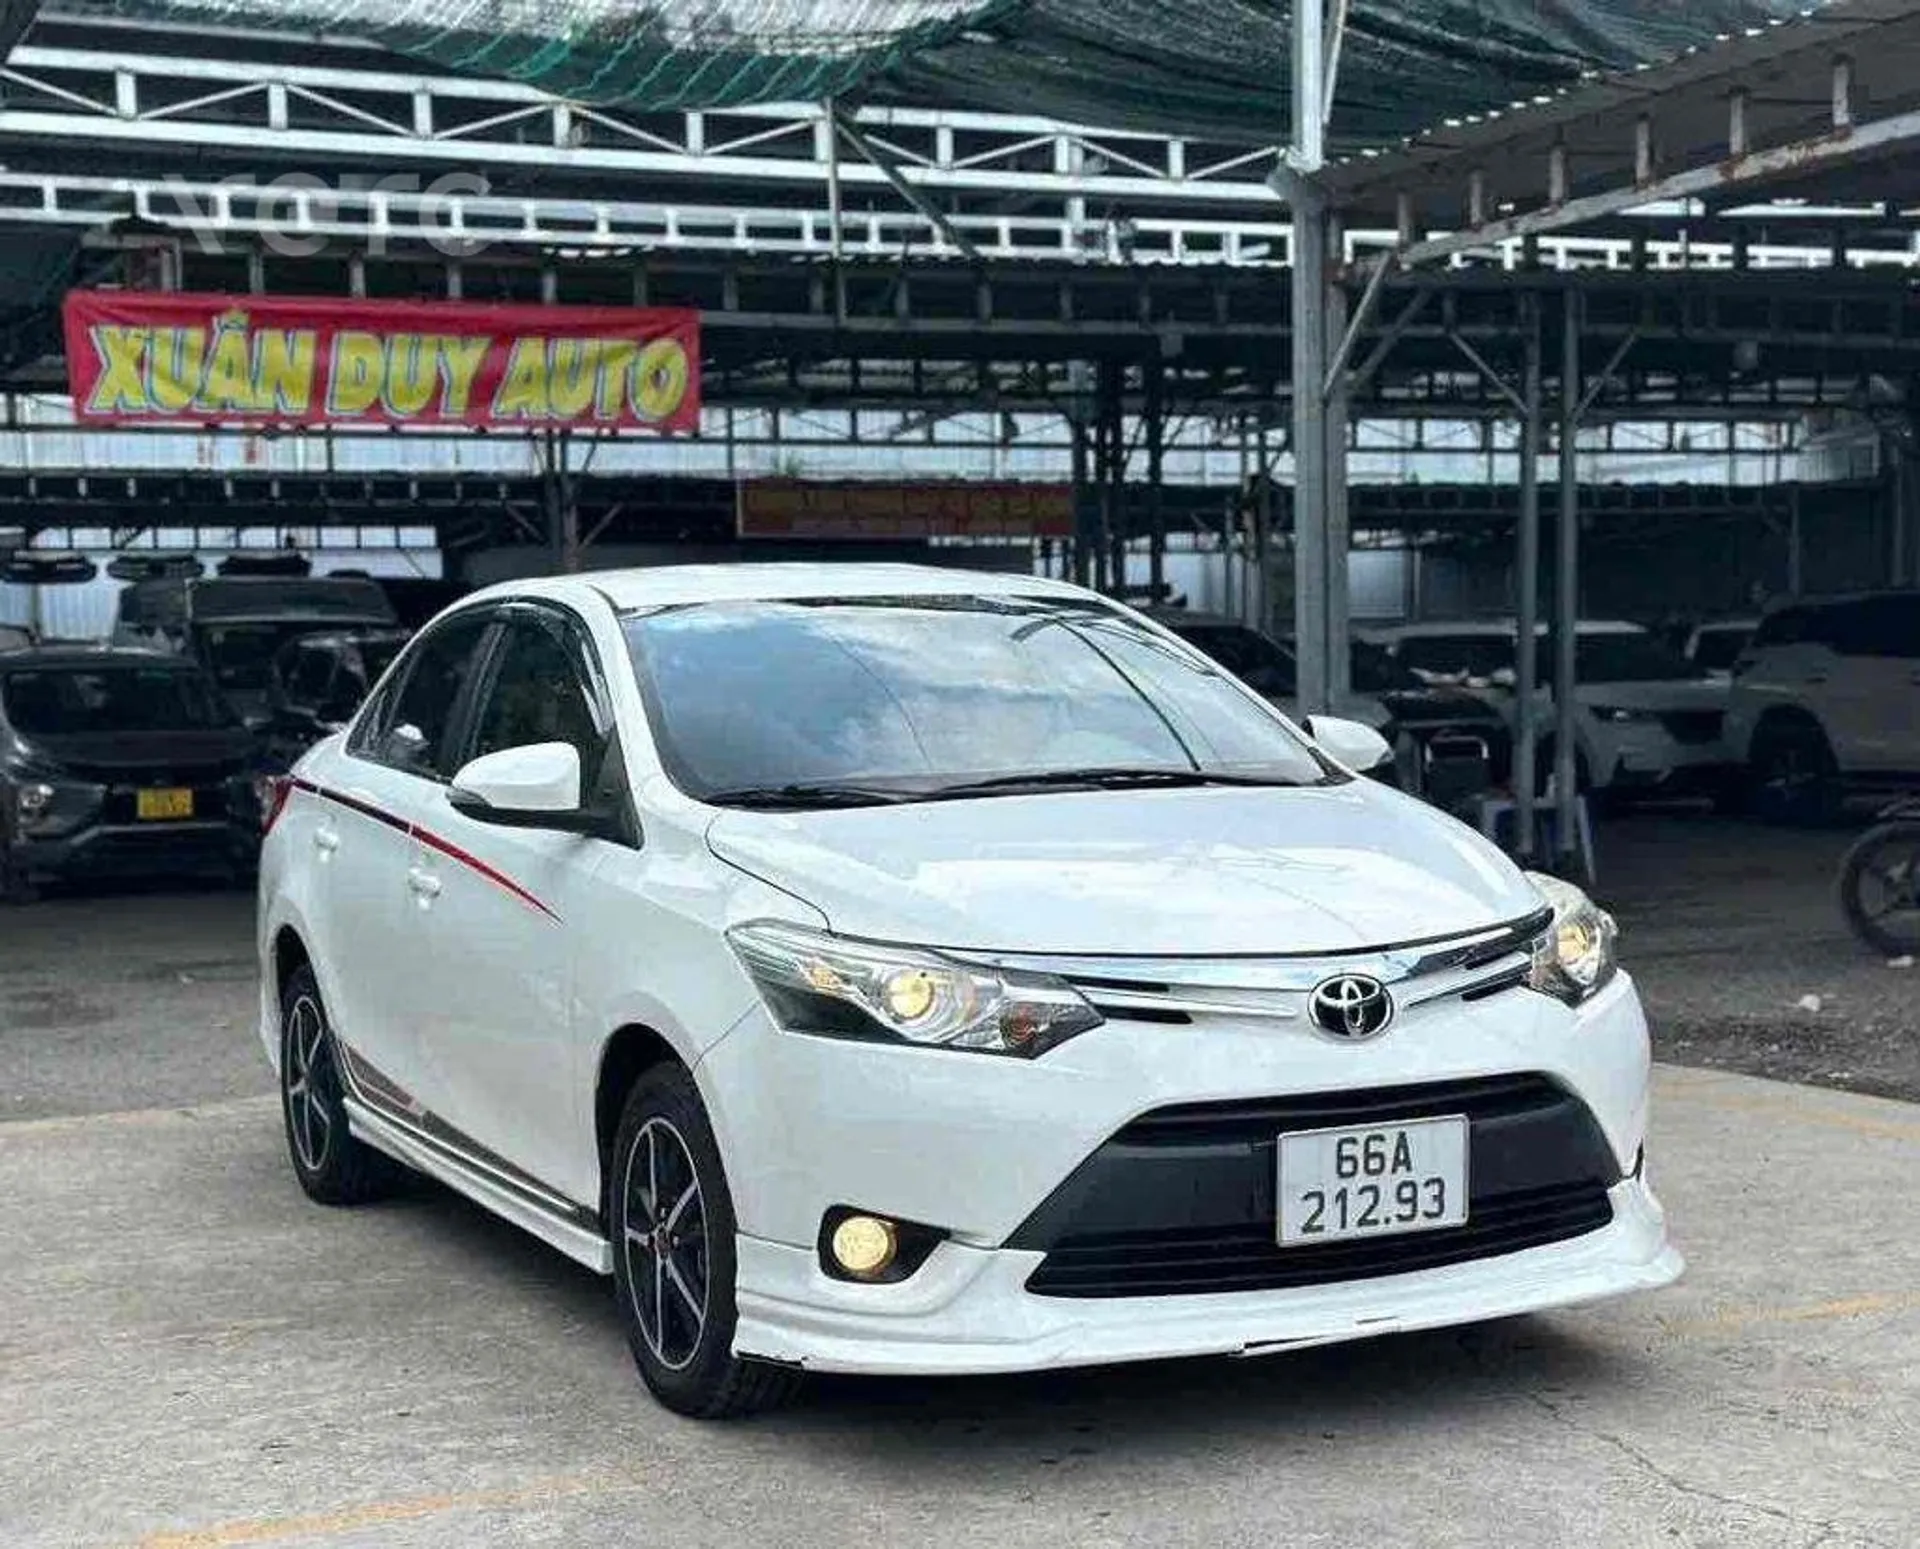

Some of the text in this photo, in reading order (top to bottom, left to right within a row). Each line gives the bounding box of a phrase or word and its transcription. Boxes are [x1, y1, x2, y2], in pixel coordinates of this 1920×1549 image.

[84, 306, 689, 422] XUÂN DUY AUTO
[1335, 1130, 1413, 1179] 66A
[1300, 1176, 1446, 1235] 212.93
